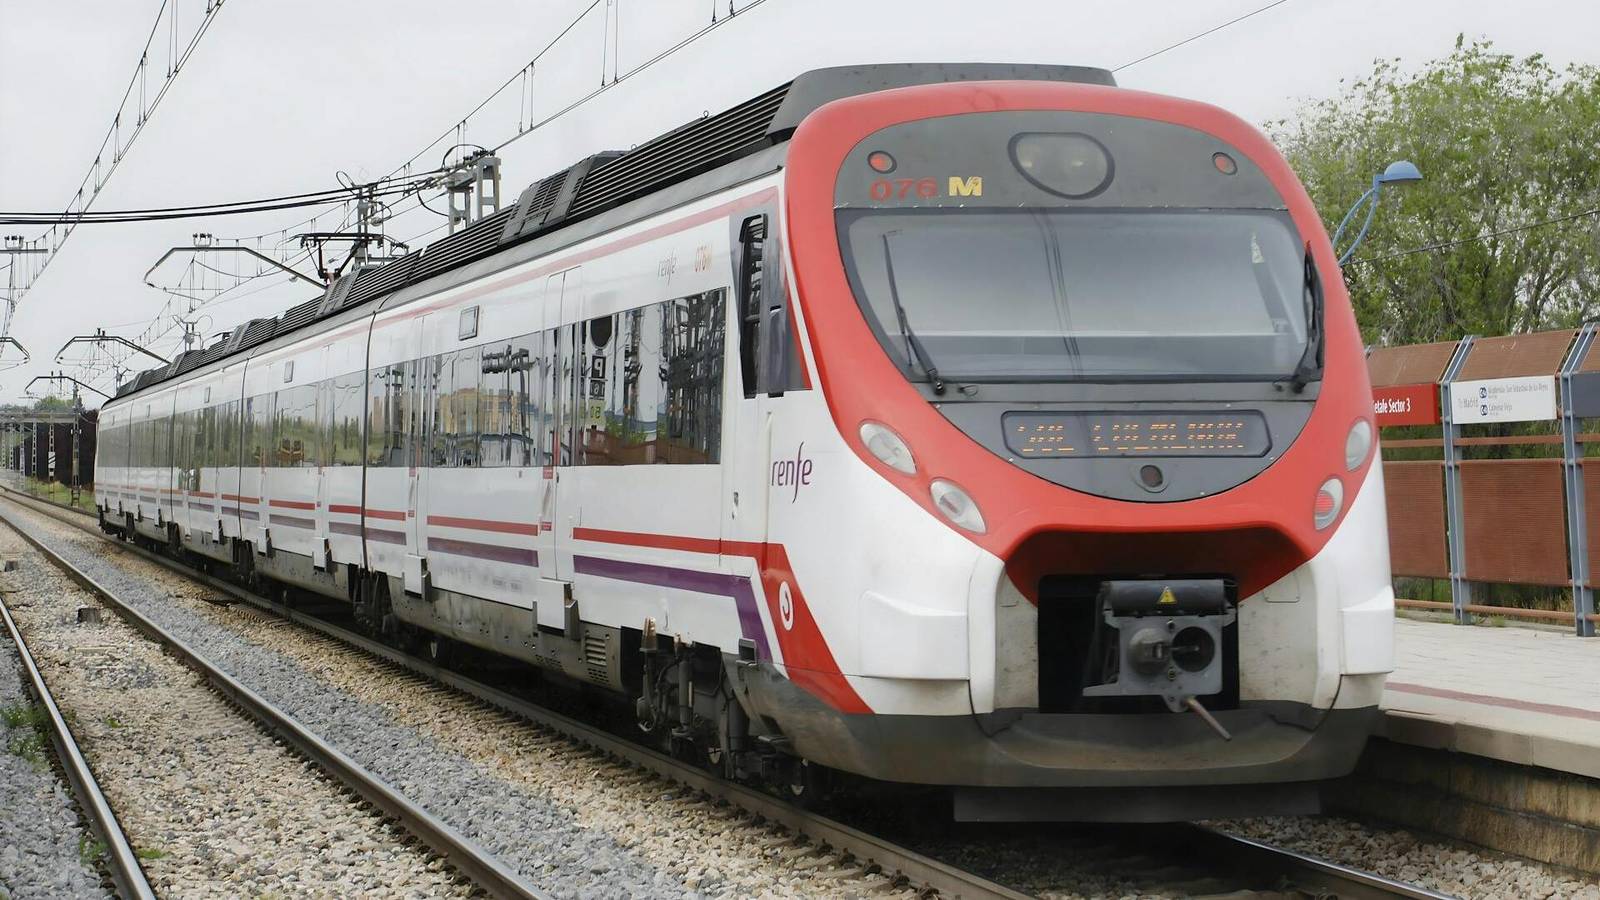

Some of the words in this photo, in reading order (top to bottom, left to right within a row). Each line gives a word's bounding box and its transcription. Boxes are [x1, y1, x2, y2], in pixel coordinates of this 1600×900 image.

[1372, 398, 1388, 414] etafe
[1388, 397, 1406, 414] Sector
[1406, 397, 1412, 413] 3
[771, 441, 812, 504] renfe
